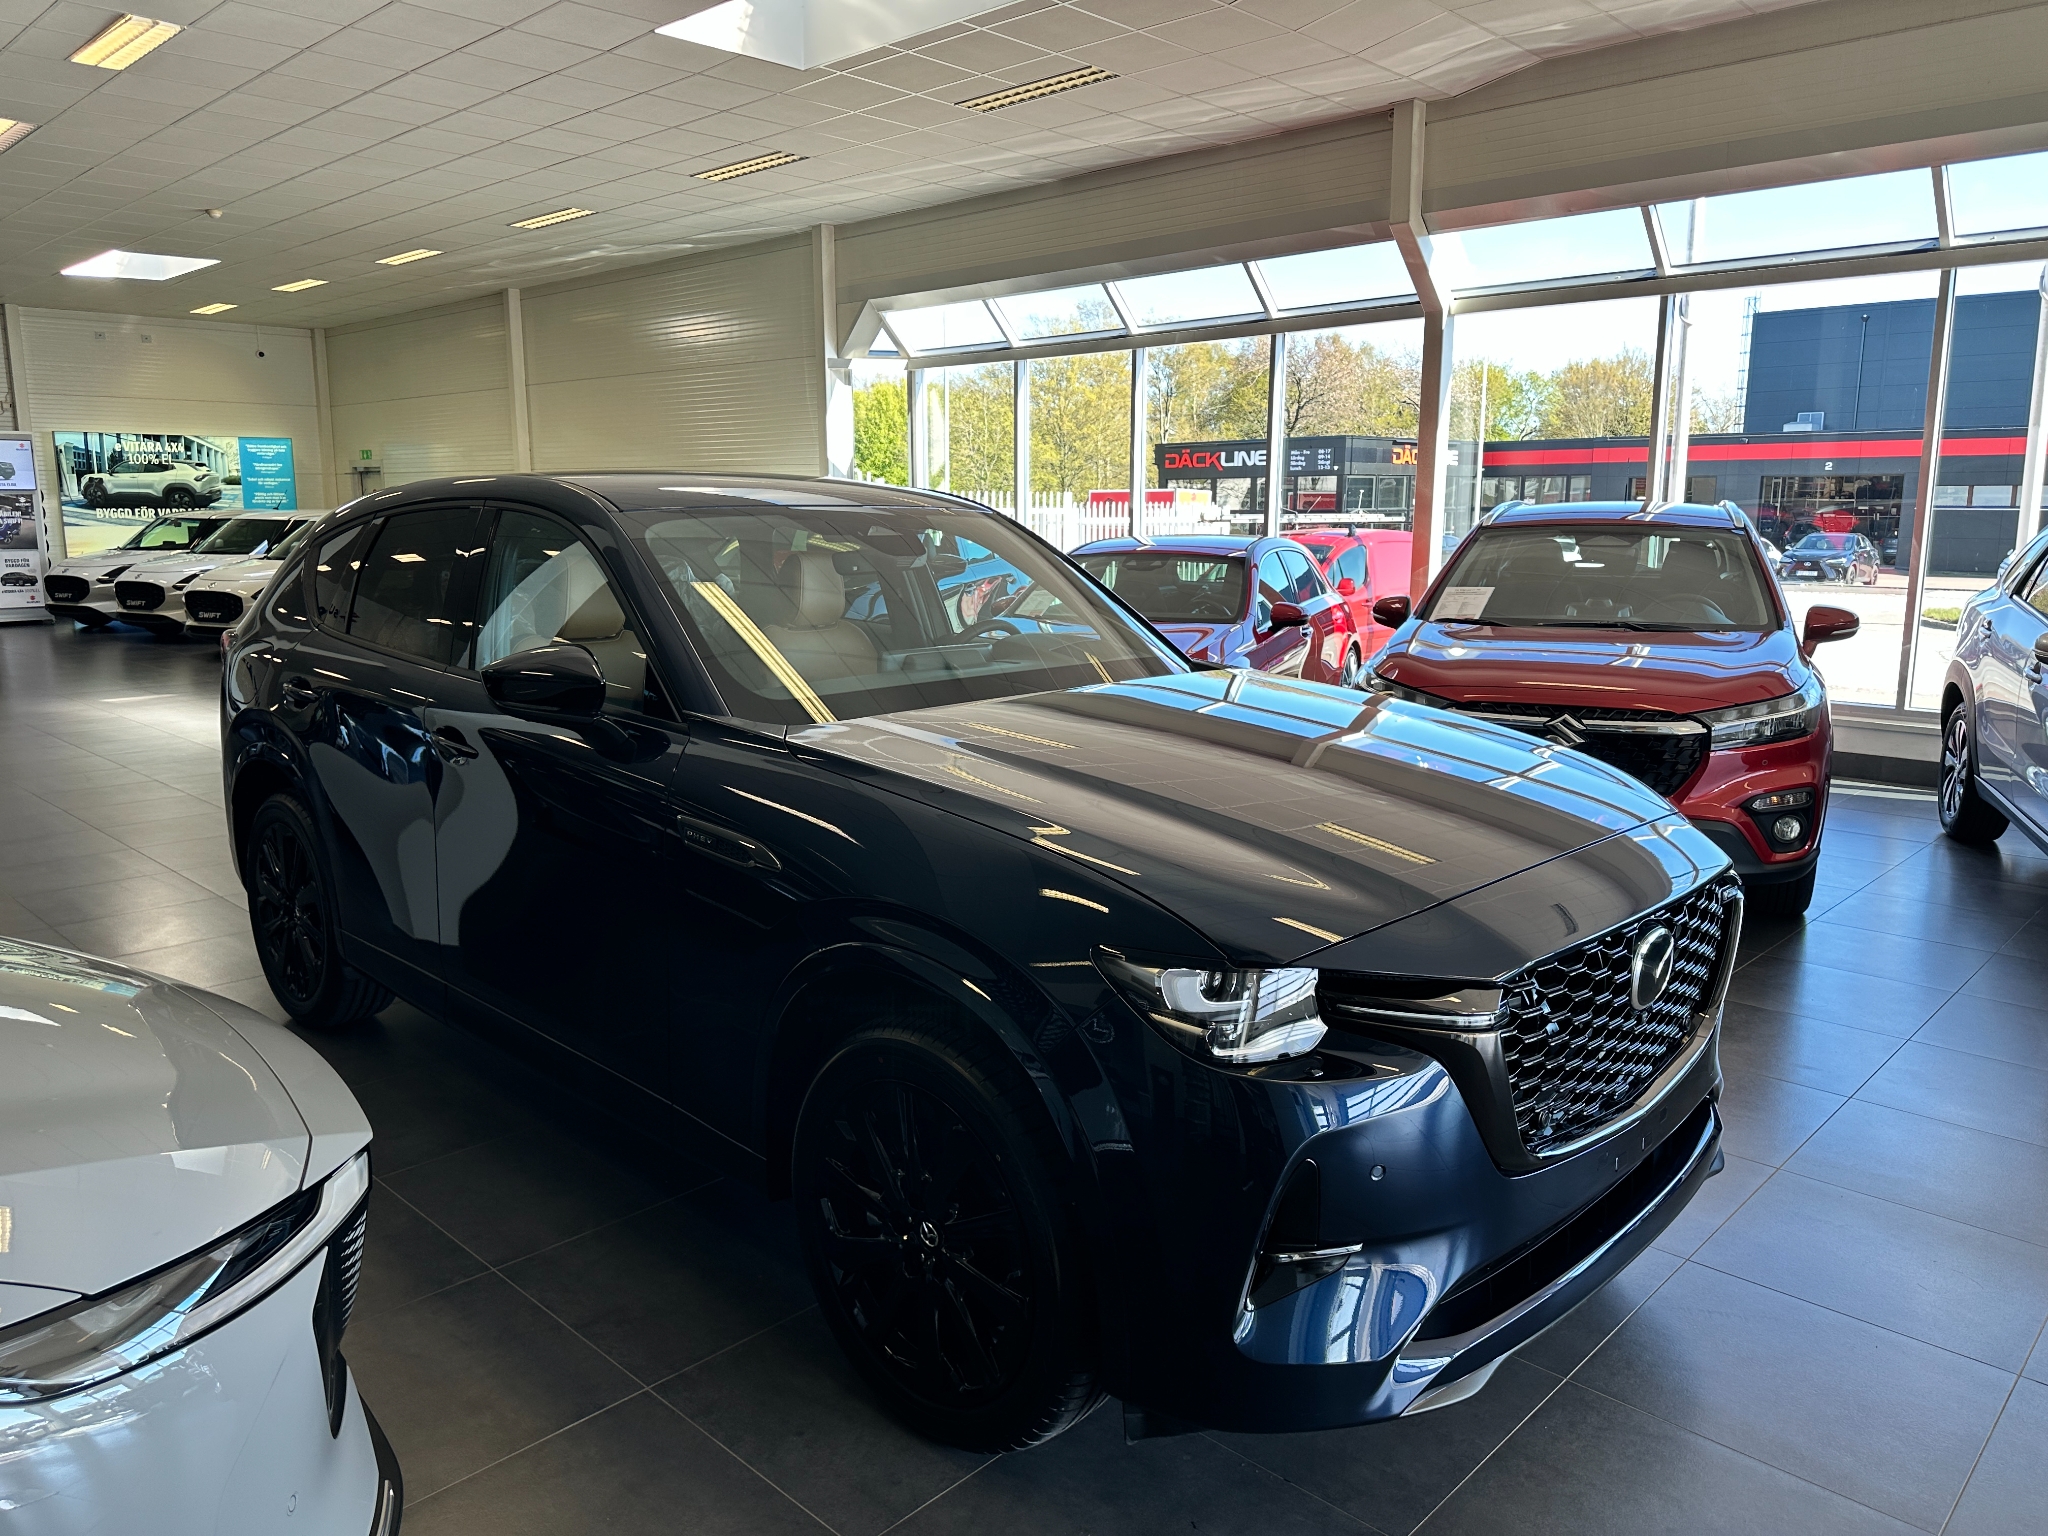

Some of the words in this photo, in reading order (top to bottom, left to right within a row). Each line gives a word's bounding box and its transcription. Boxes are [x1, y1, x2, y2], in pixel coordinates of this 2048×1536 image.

[122, 441, 163, 452] VITARA
[165, 442, 185, 453] 4X4
[128, 453, 160, 464] 100%
[162, 454, 174, 464] EL
[1164, 448, 1267, 471] DÄCKLINE
[1824, 461, 1833, 471] 2
[95, 507, 133, 519] BYGGD
[135, 506, 156, 519] FÖR
[126, 599, 146, 607] SWIFT
[198, 611, 222, 619] SWIFT
[687, 830, 712, 844] PHEV
